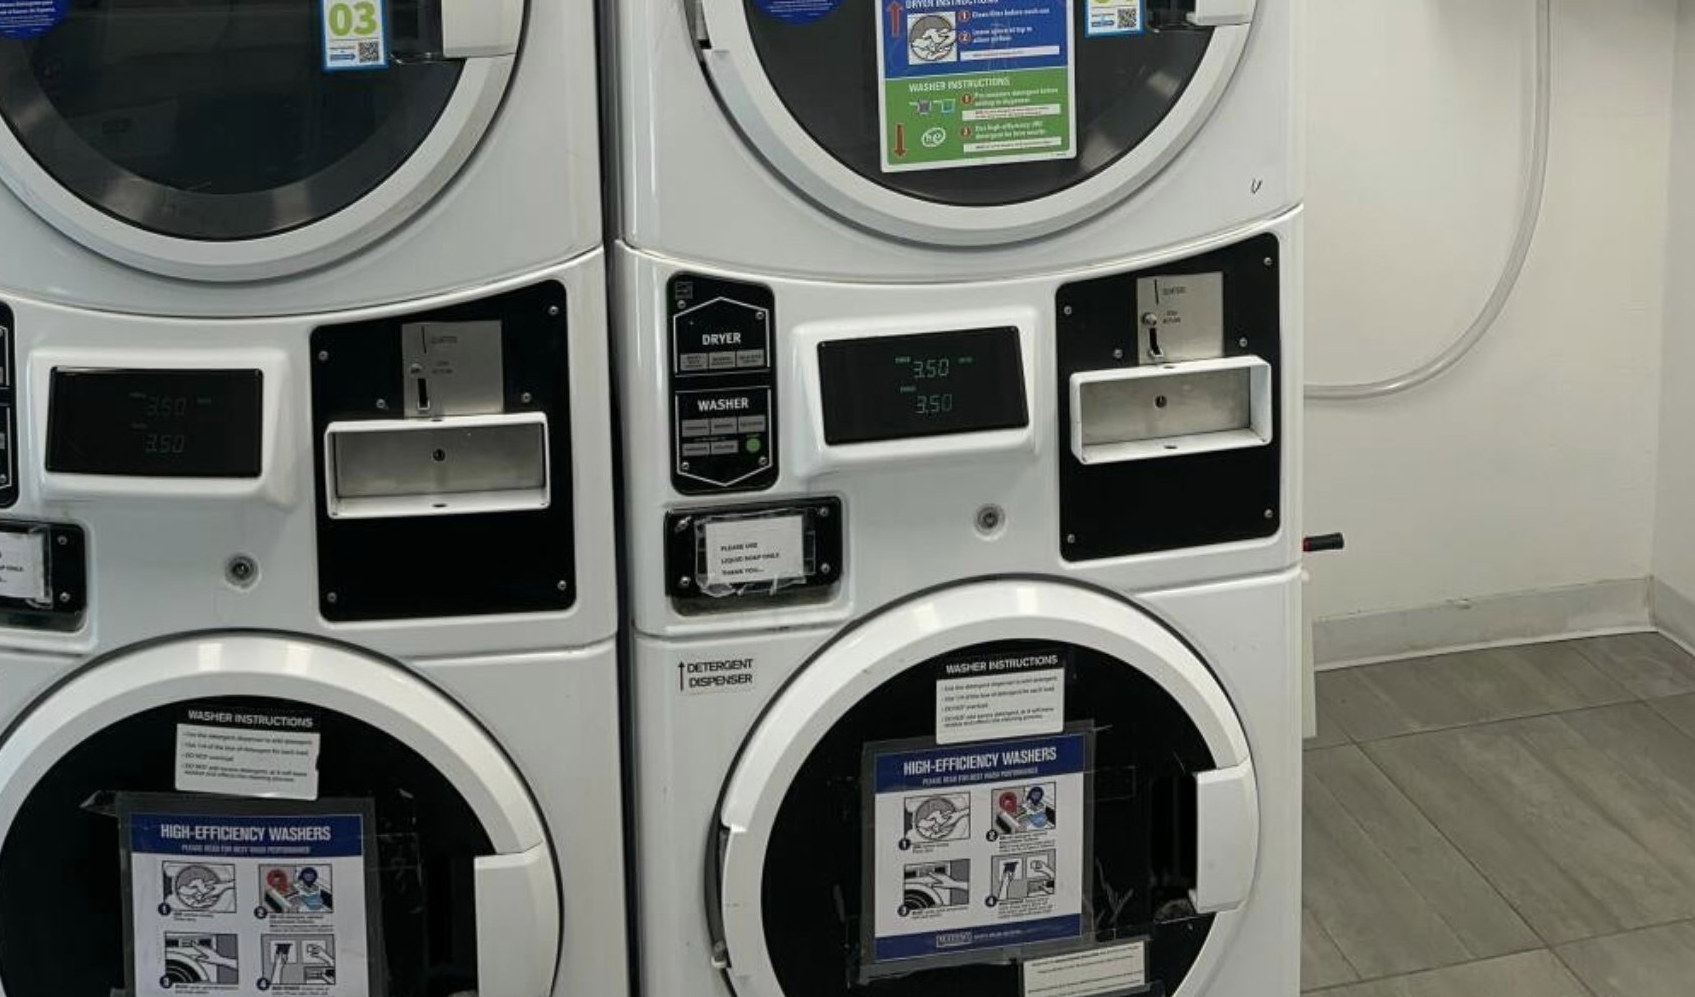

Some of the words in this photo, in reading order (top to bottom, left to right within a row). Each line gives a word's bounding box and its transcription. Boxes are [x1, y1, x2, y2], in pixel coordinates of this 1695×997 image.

[329, 2, 378, 37] 03
[908, 81, 946, 92] WASHER
[947, 77, 1011, 90] INSTRUCTIONS
[701, 332, 742, 346] DRYER
[697, 397, 749, 412] WASHER
[687, 658, 754, 674] DETERGENT
[946, 662, 987, 674] WASHER
[988, 654, 1059, 671] INSTRUCTIONS
[689, 674, 753, 688] DISPENSER
[188, 709, 232, 723] WASHER
[234, 714, 313, 728] INSTRUCTIONS
[903, 754, 999, 776] HIGH-EFFICIENCY
[1002, 746, 1057, 766] WASHERS
[160, 823, 265, 842] HIGH-EFFICIENCY
[268, 825, 332, 842] WASHERS
